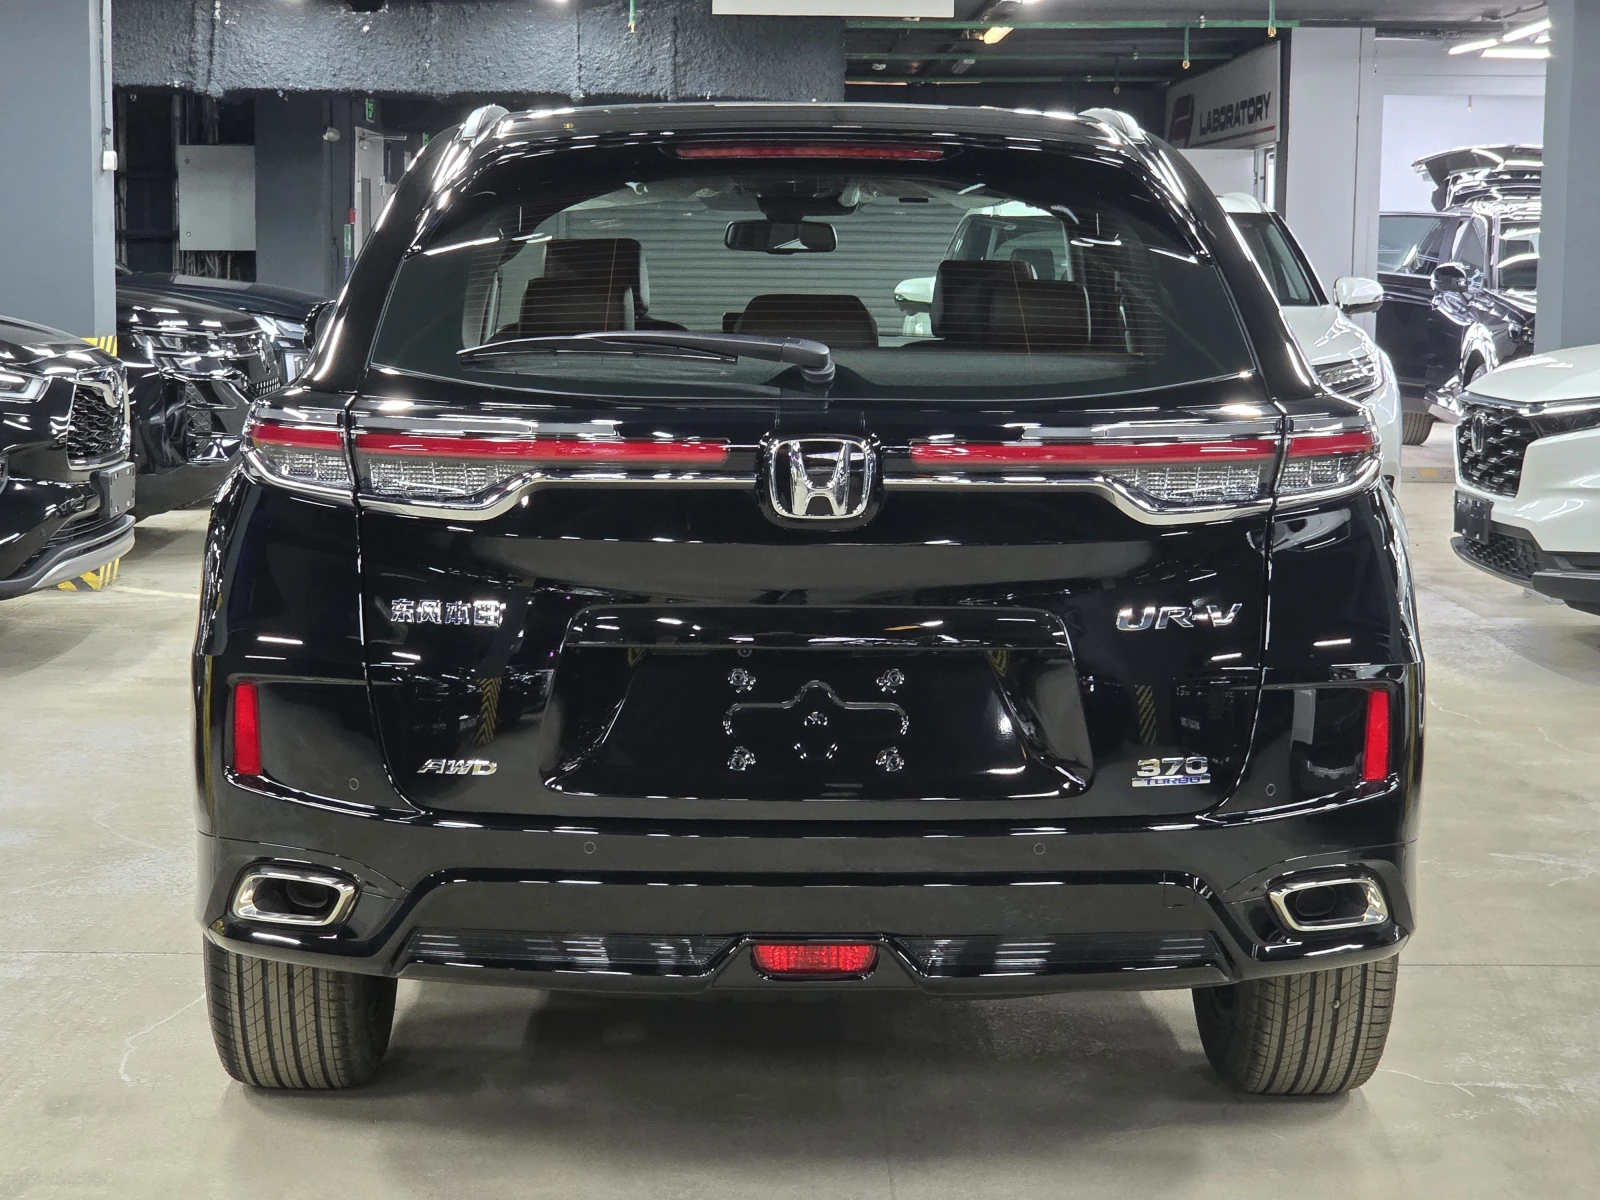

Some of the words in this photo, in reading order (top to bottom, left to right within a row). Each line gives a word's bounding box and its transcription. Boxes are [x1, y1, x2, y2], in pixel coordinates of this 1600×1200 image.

[1200, 92, 1271, 135] LABORATORY
[1116, 603, 1242, 631] UR-V
[417, 758, 498, 776] AWD
[1136, 756, 1208, 776] 370
[1143, 775, 1201, 786] TURBO
